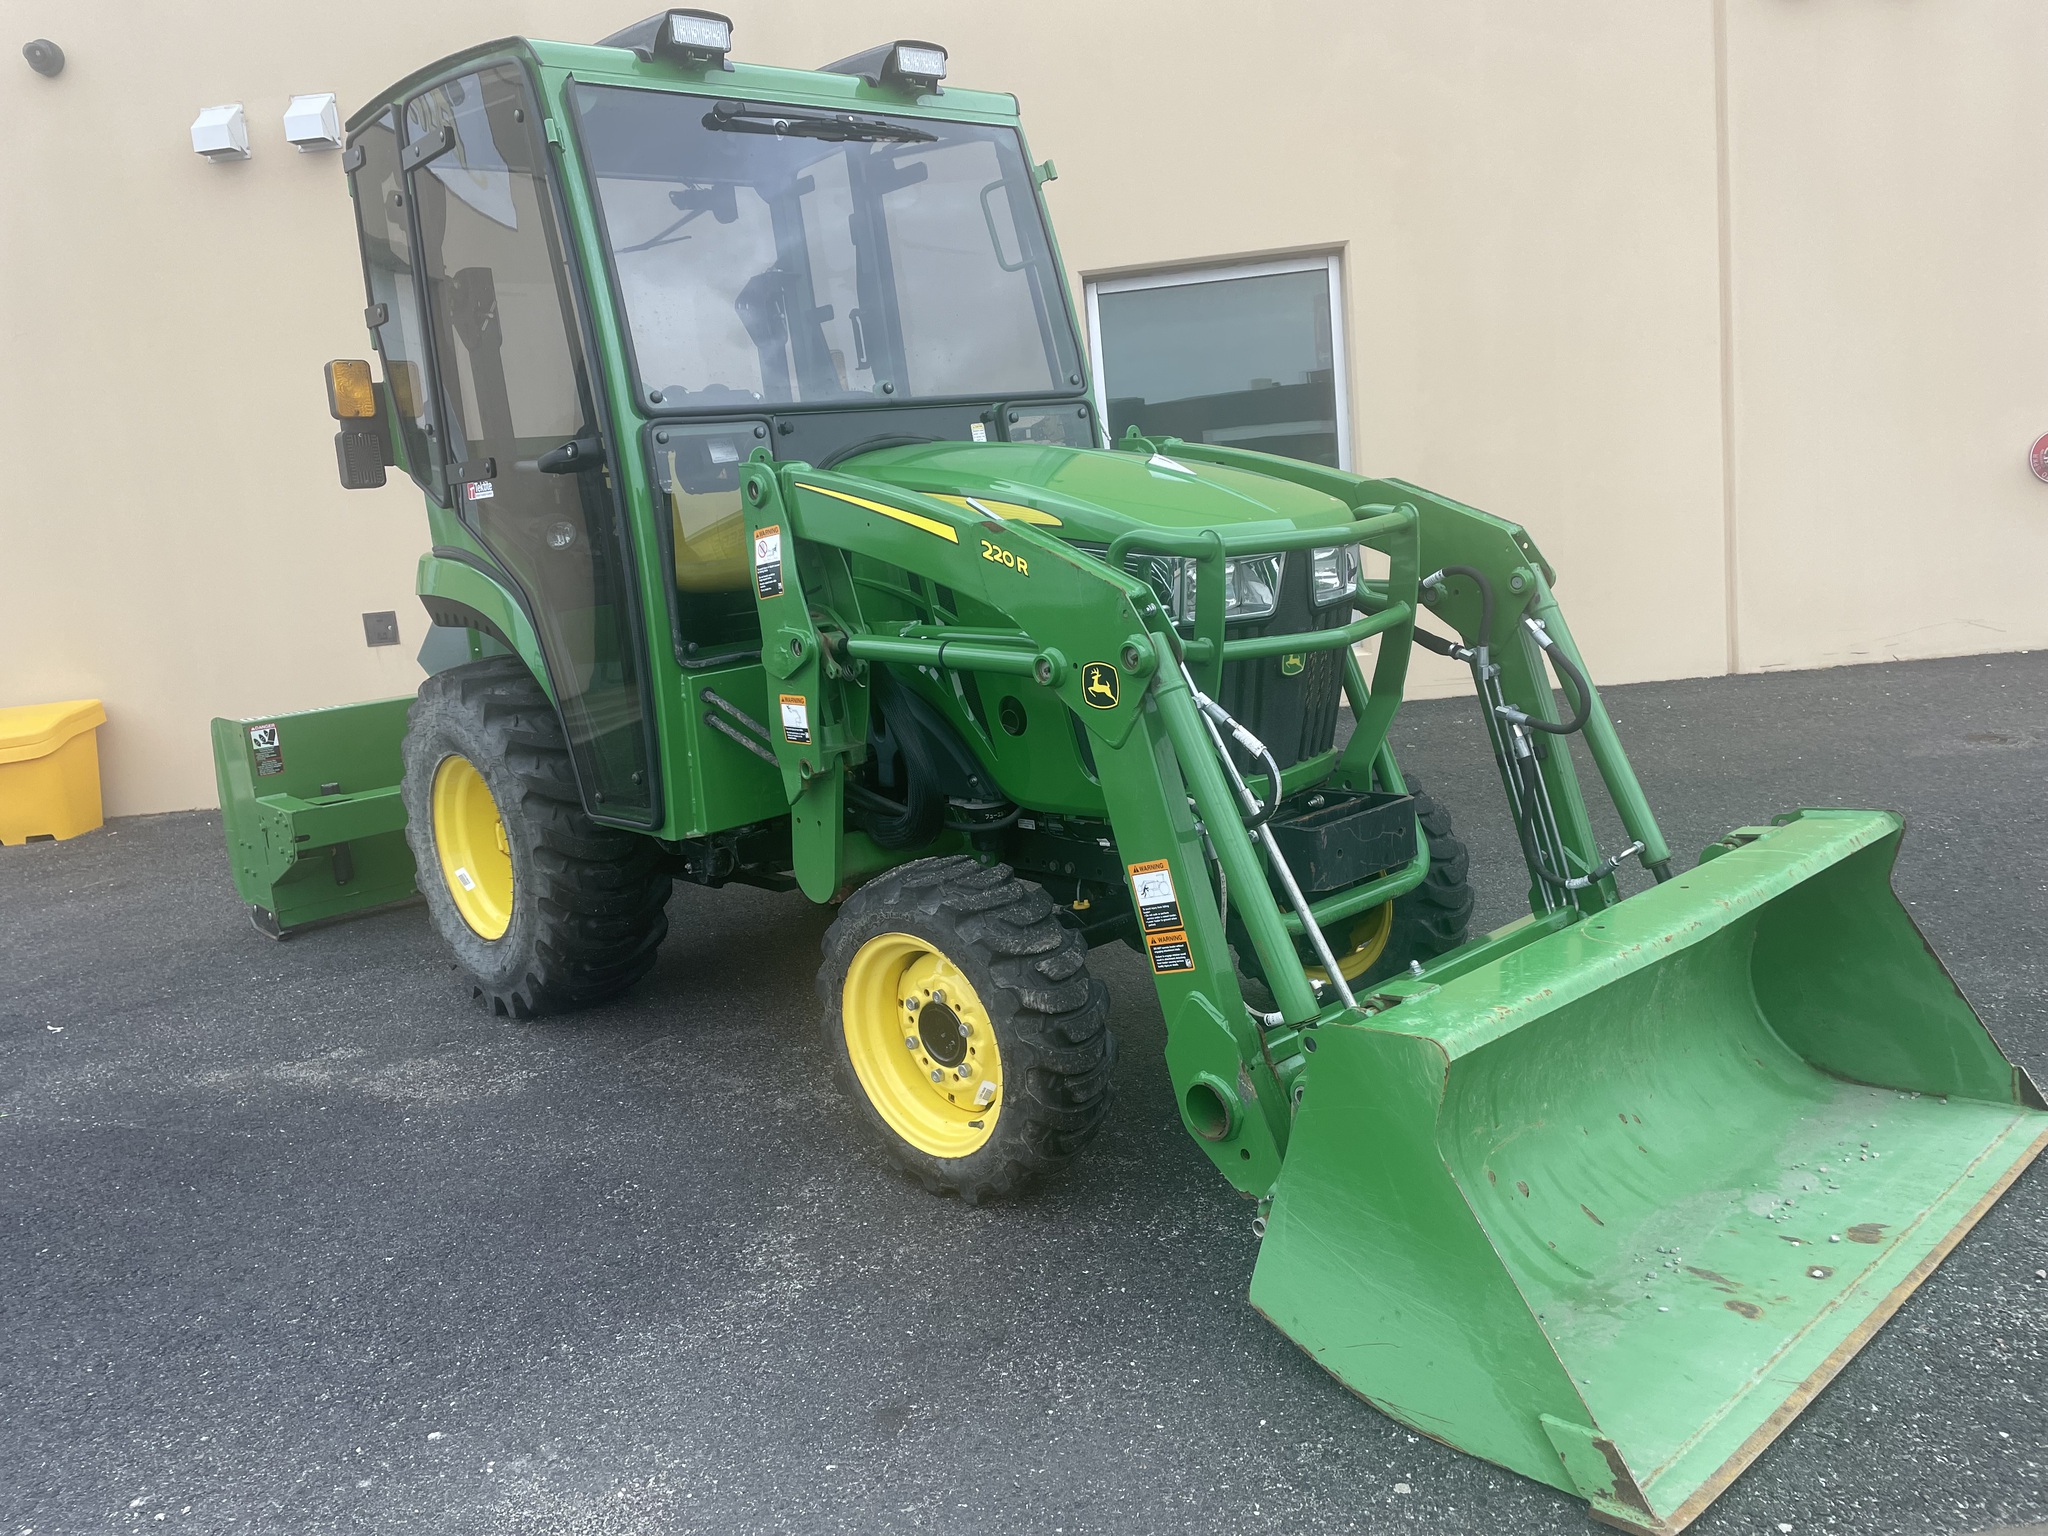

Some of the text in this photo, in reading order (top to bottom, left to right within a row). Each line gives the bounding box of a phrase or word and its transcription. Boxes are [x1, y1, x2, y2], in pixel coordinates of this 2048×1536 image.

[758, 526, 779, 537] WARNING
[784, 696, 805, 705] WARNING
[1138, 862, 1164, 872] WARNING
[1158, 934, 1183, 943] WARNING
